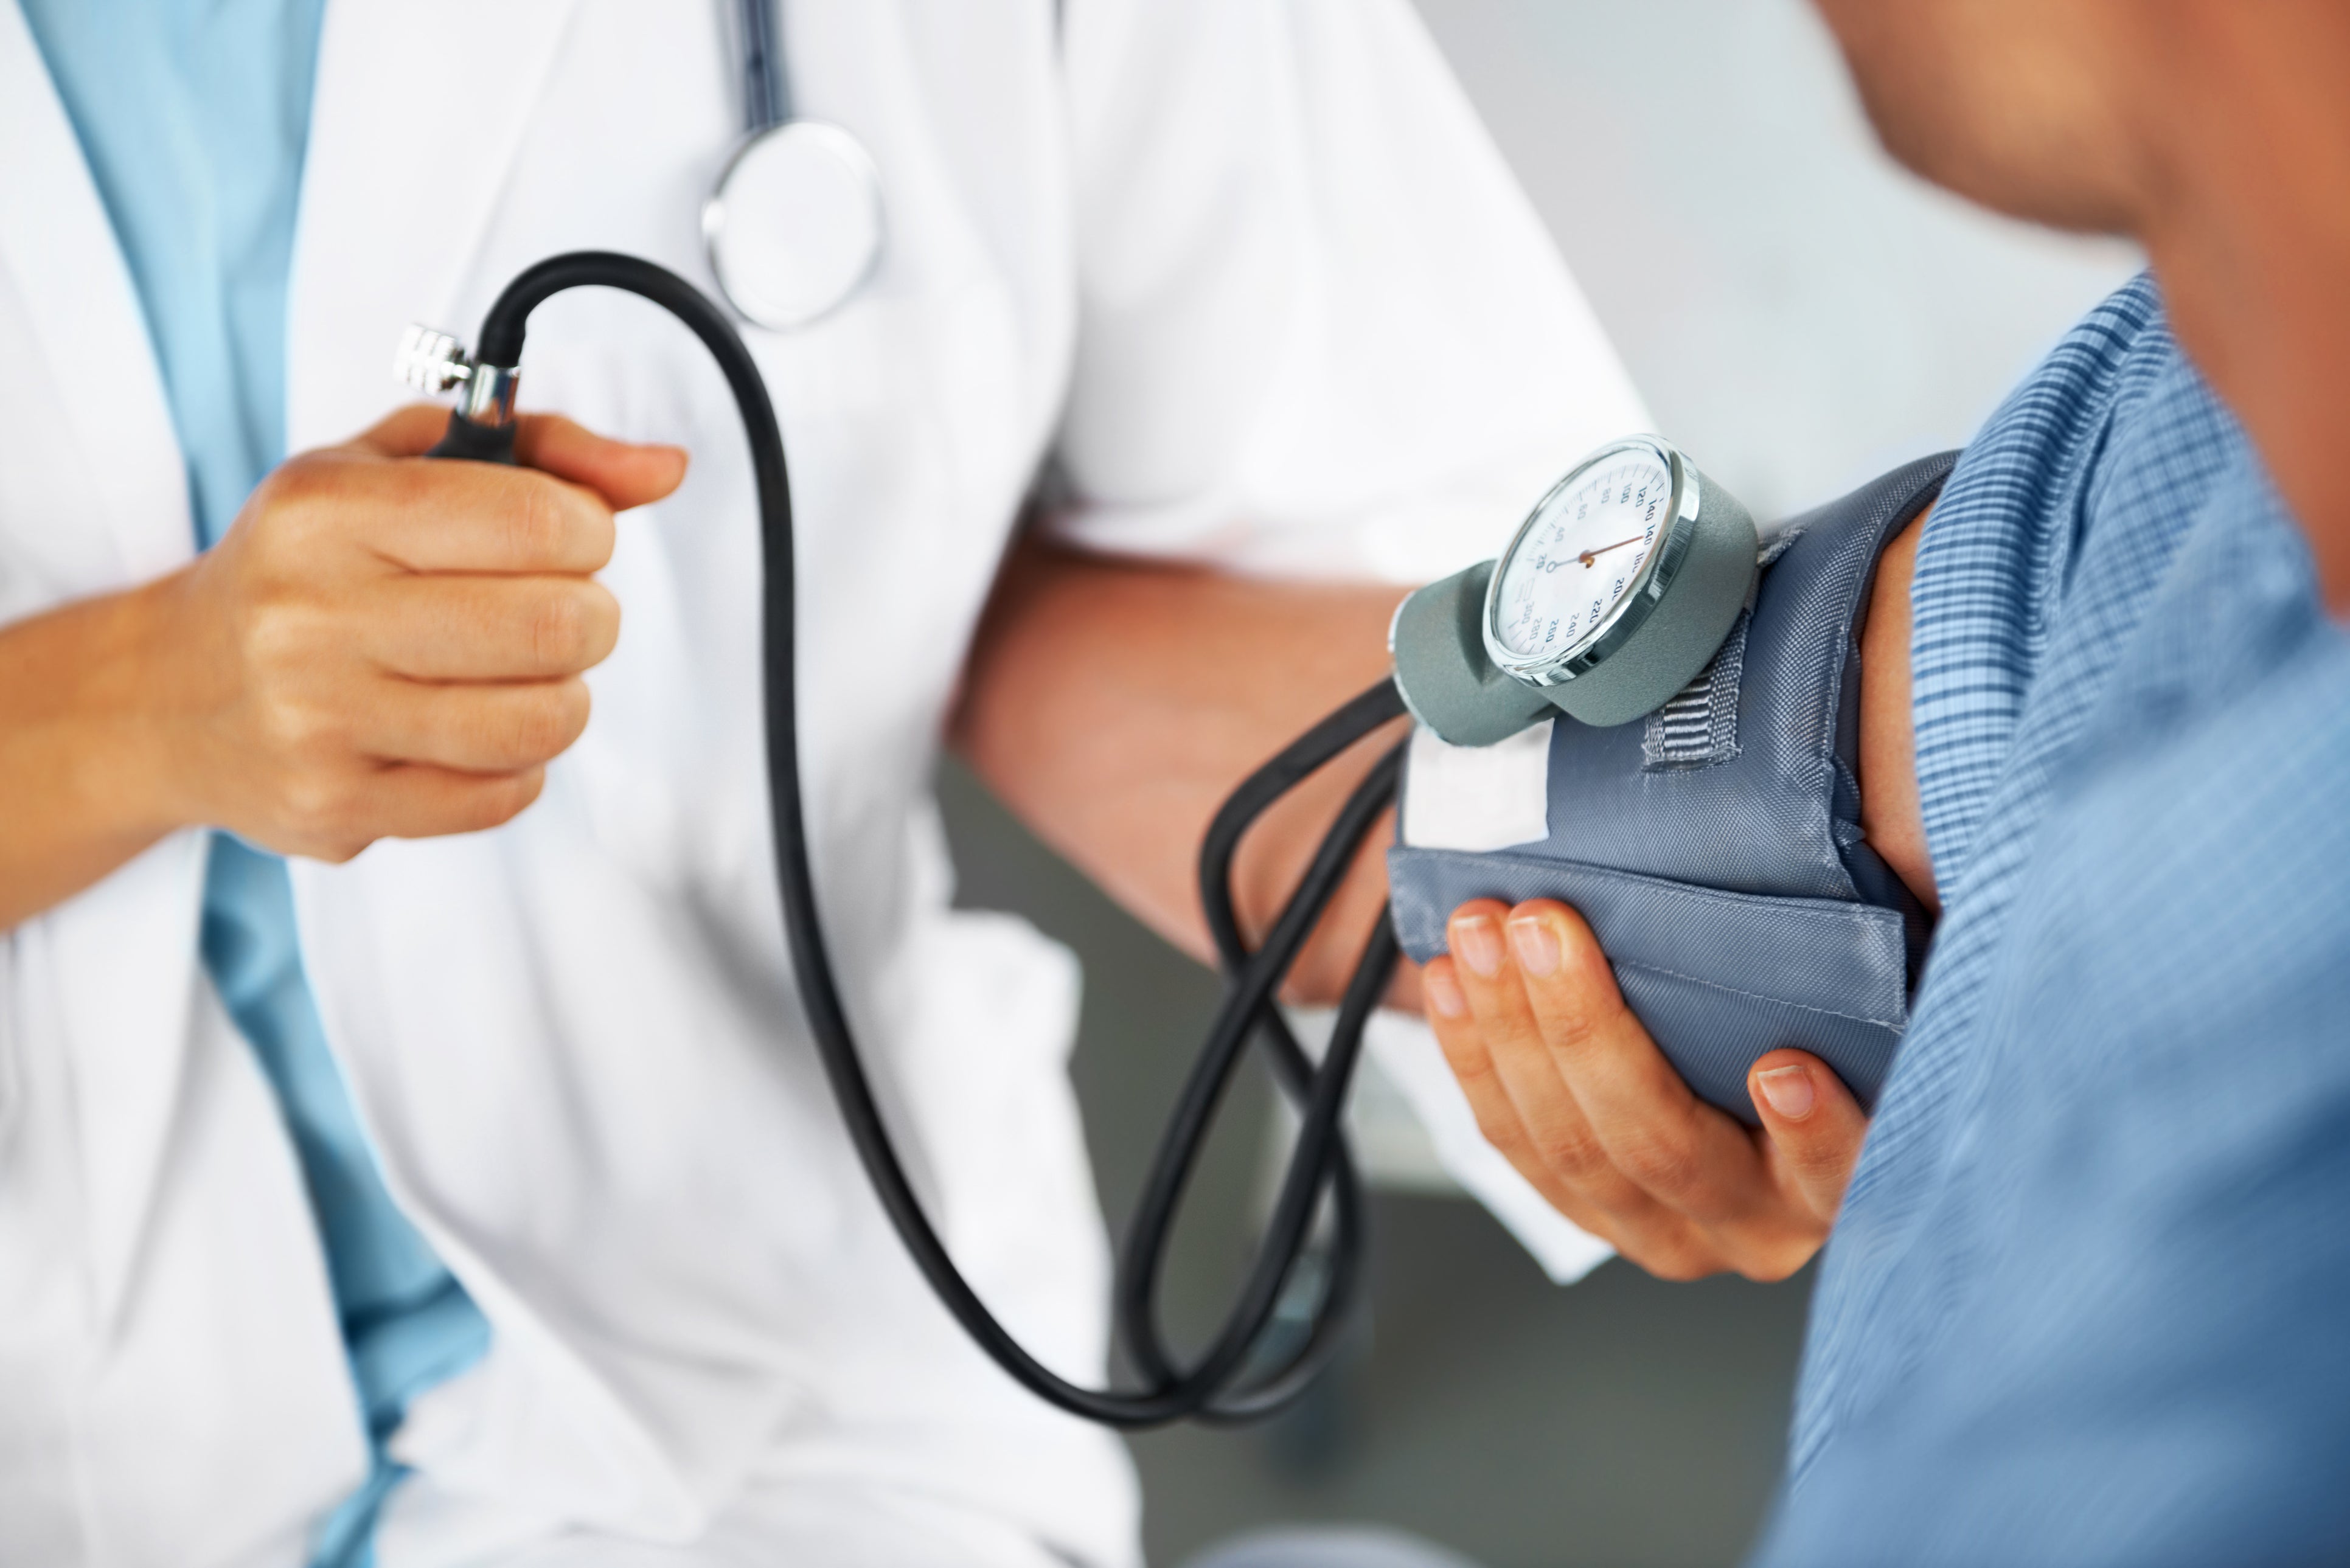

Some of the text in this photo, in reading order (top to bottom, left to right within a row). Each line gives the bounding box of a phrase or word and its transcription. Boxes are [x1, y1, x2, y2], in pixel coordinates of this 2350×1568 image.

[1621, 482, 1632, 504] 100
[1636, 485, 1647, 507] 120
[1645, 499, 1657, 521] 140
[1644, 523, 1655, 545] 140
[1521, 601, 1534, 624] 300
[1529, 617, 1542, 640] 280
[1546, 619, 1559, 642] 260
[1566, 612, 1580, 637] 240
